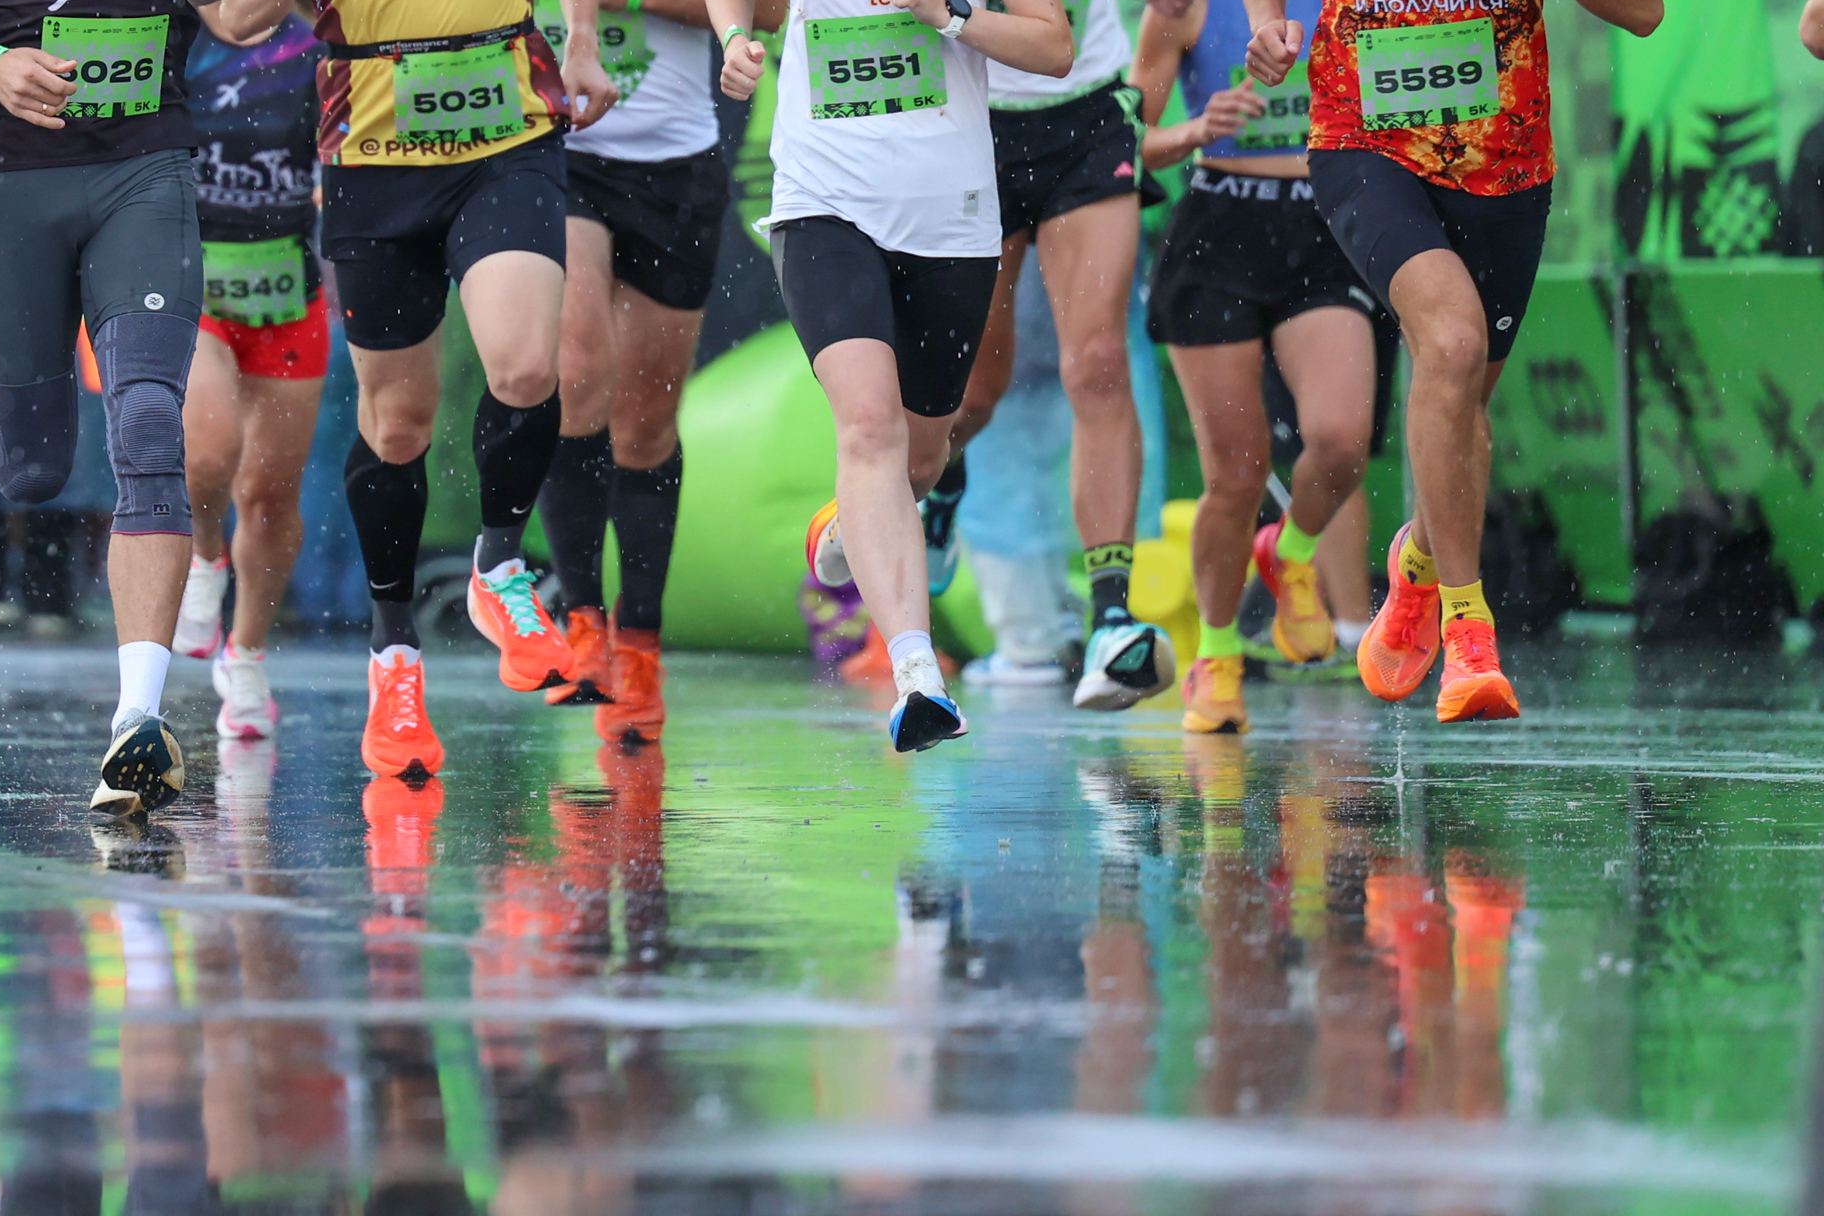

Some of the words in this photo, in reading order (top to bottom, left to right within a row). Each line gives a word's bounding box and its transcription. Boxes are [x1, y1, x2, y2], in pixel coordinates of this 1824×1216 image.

[543, 26, 626, 47] 59
[828, 52, 921, 84] 5551
[1374, 61, 1482, 94] 5589
[134, 101, 151, 111] 5K
[413, 84, 504, 114] 5031
[914, 95, 935, 106] 5K
[1469, 103, 1489, 116] 5K
[496, 124, 514, 135] 5K
[207, 274, 295, 298] 5340
